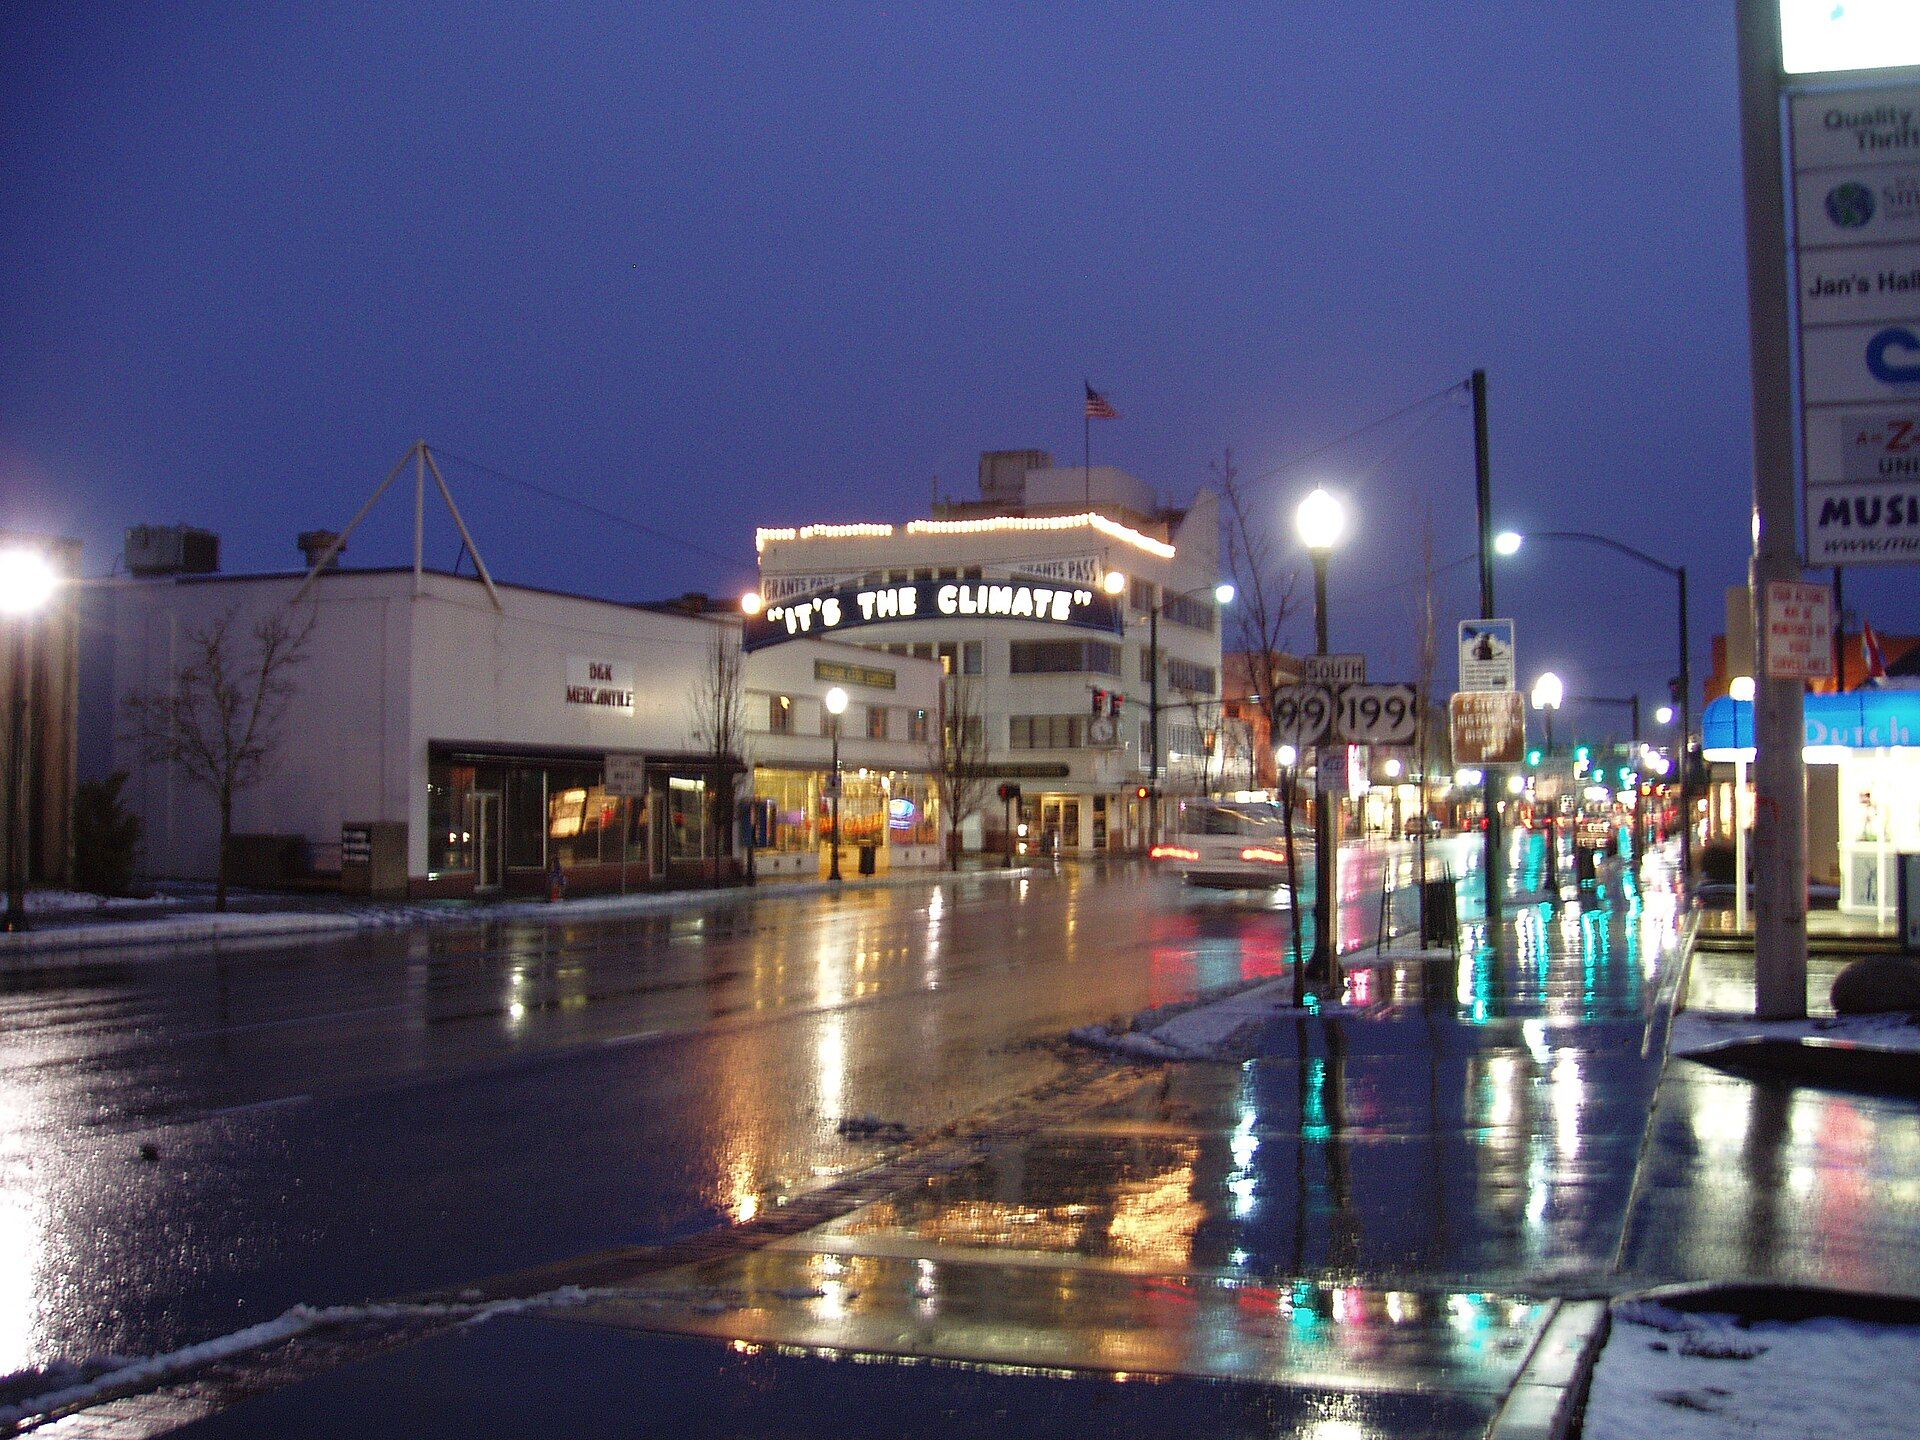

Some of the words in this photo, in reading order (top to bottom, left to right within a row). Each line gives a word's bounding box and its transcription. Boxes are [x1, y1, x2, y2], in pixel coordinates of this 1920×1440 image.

[1824, 106, 1911, 129] Quality
[1808, 272, 1871, 298] Jan's
[1819, 494, 1919, 526] MUSI
[1068, 558, 1098, 583] PASS
[856, 586, 918, 620] THE
[566, 684, 632, 707] MERCANTILE
[1349, 696, 1406, 729] 199
